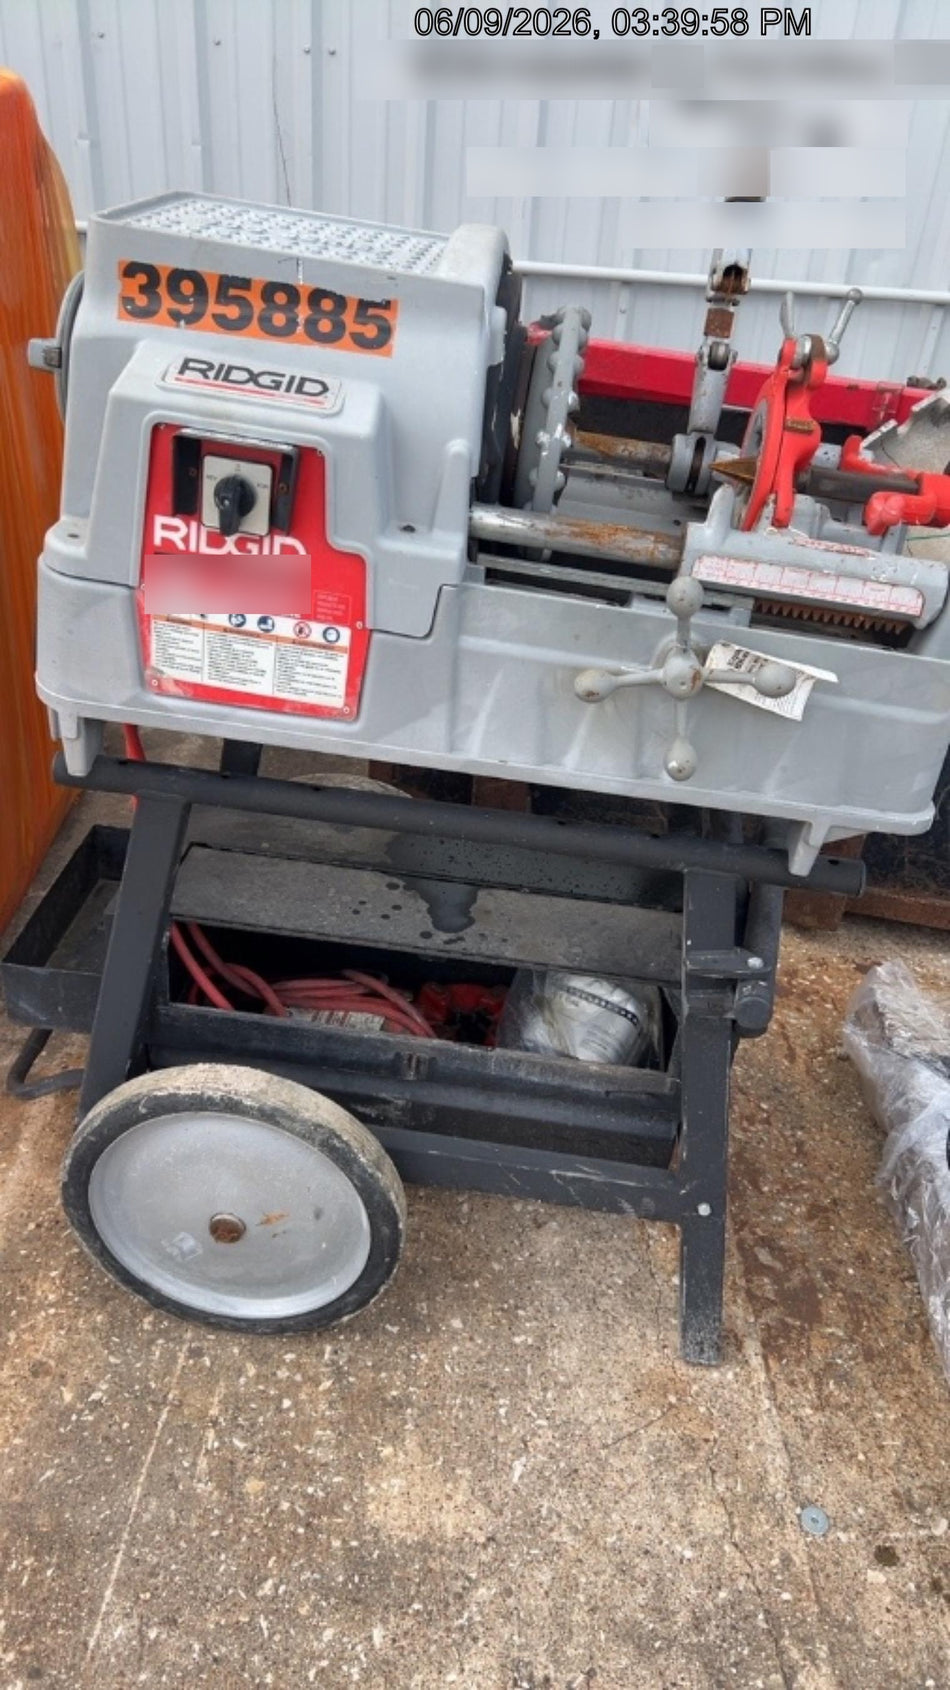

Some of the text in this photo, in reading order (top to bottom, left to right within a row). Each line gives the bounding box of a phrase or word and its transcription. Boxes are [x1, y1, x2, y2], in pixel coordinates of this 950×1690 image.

[121, 260, 393, 350] 395885
[178, 357, 330, 398] RIDGID
[153, 514, 307, 555] RIDGID
